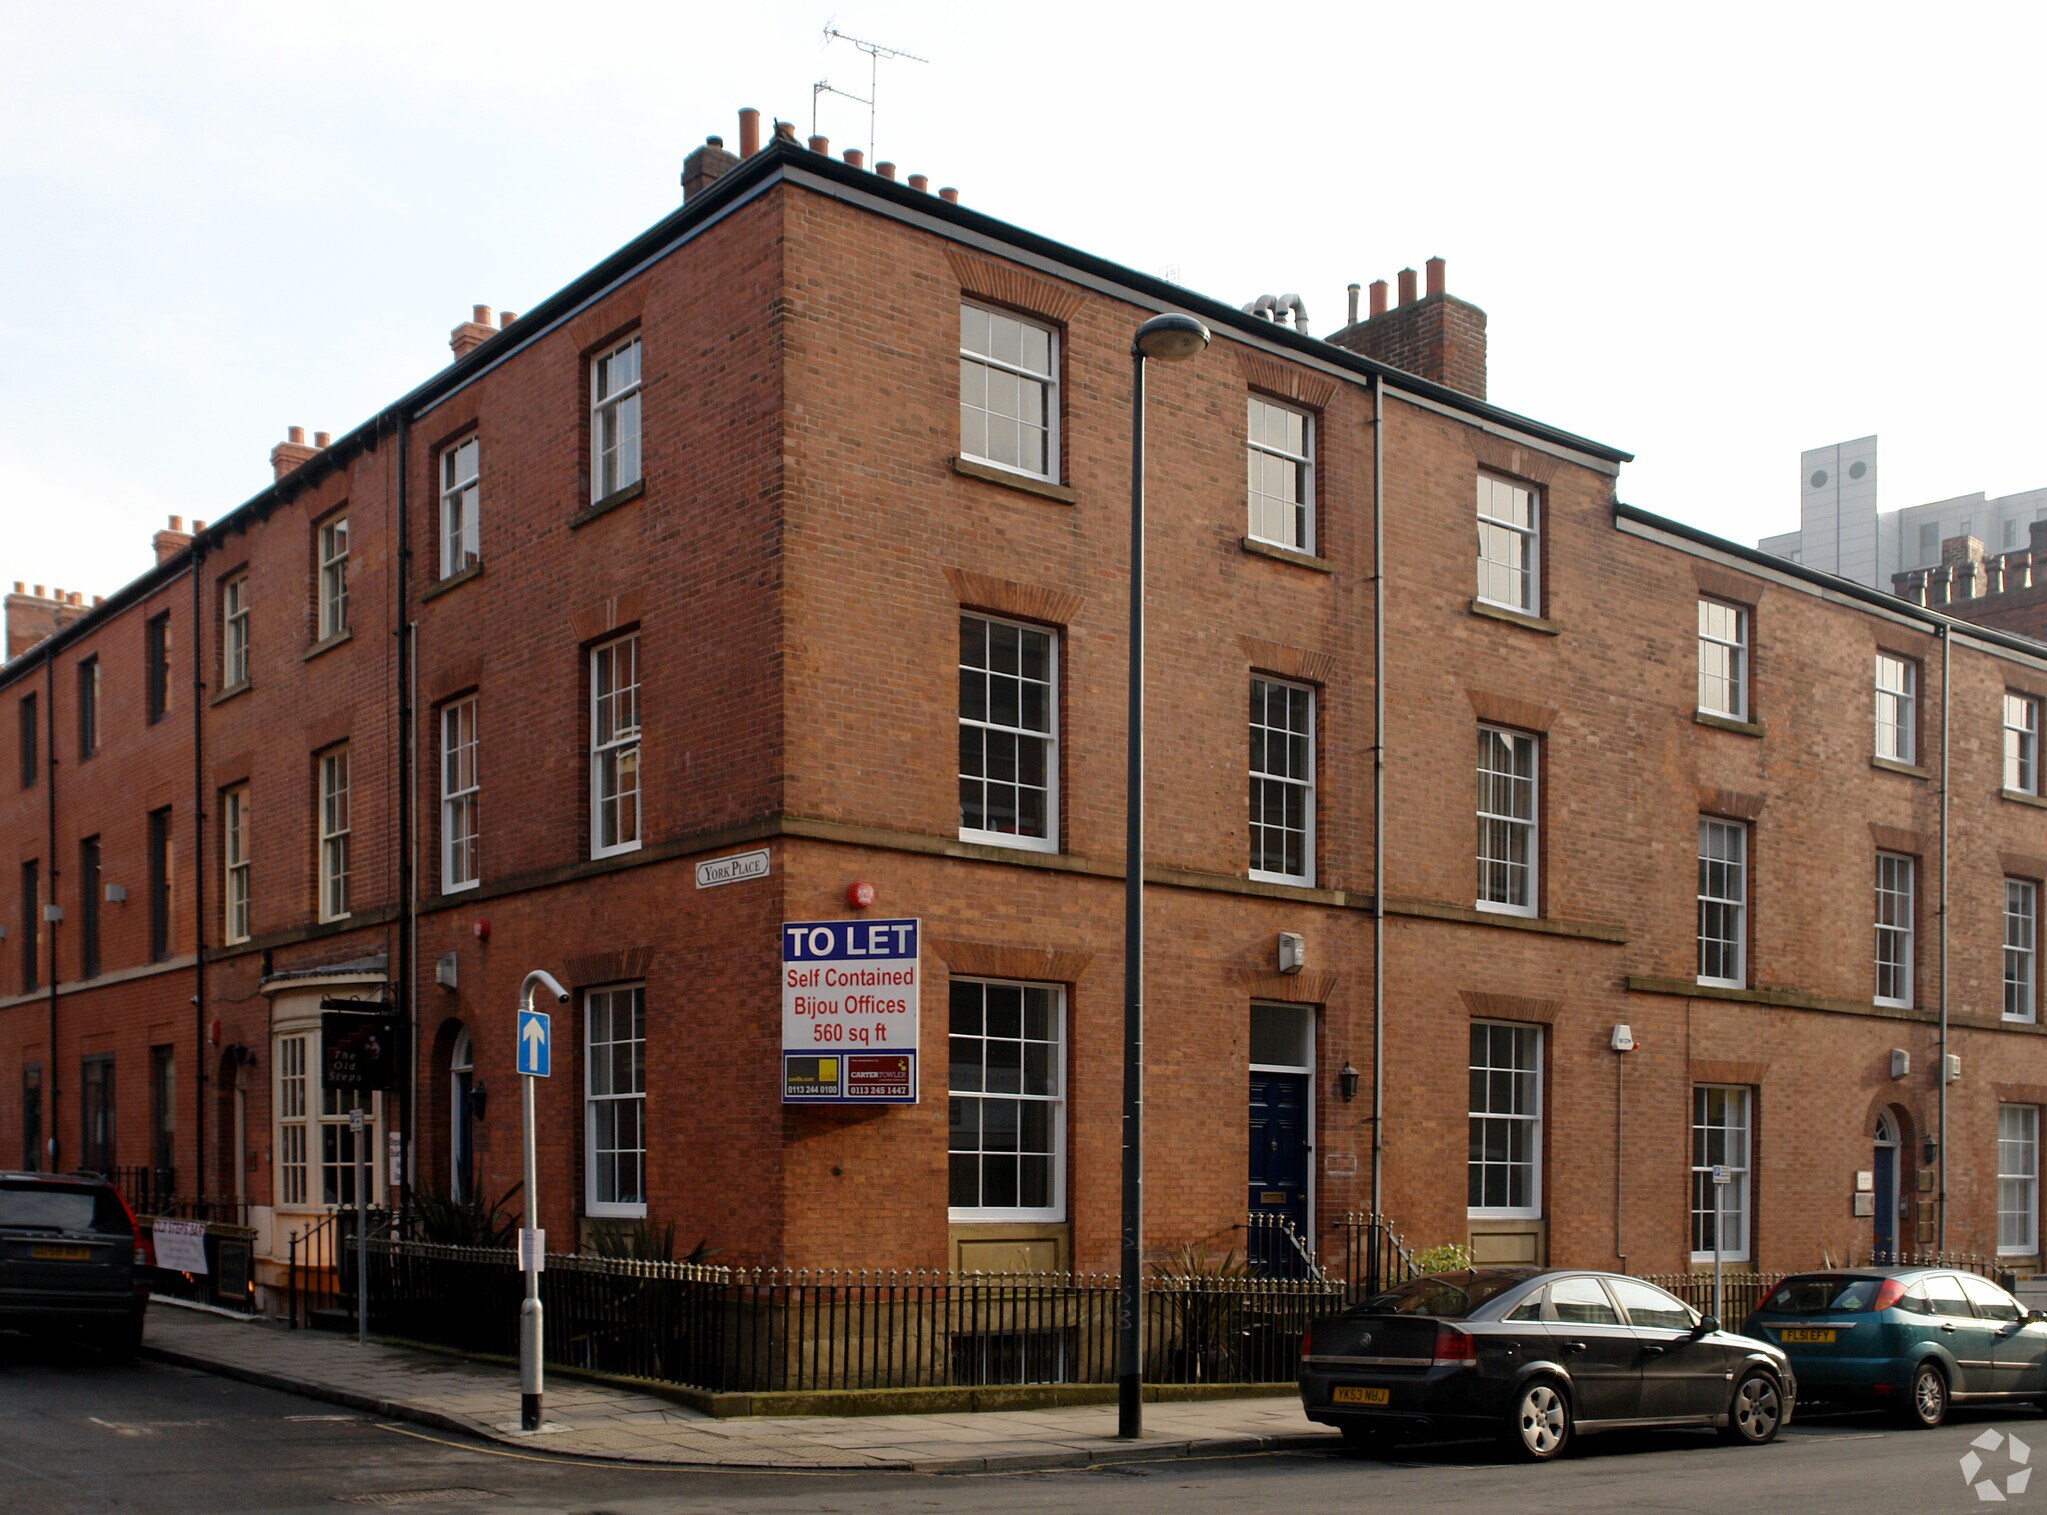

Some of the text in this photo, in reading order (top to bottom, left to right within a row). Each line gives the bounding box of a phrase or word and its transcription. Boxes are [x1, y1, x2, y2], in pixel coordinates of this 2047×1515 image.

[787, 924, 914, 957] TO LET
[787, 966, 914, 988] Self Contained
[794, 995, 906, 1020] Bijou Offices
[813, 1022, 887, 1047] 560 sq ft
[334, 1050, 357, 1060] The
[334, 1060, 357, 1071] Old
[328, 1071, 363, 1083] Steps
[788, 1085, 838, 1094] 0113 244 0100
[850, 1086, 907, 1095] 0113 245 1447
[1810, 1330, 1830, 1341] EFY
[1339, 1388, 1363, 1401] YK53
